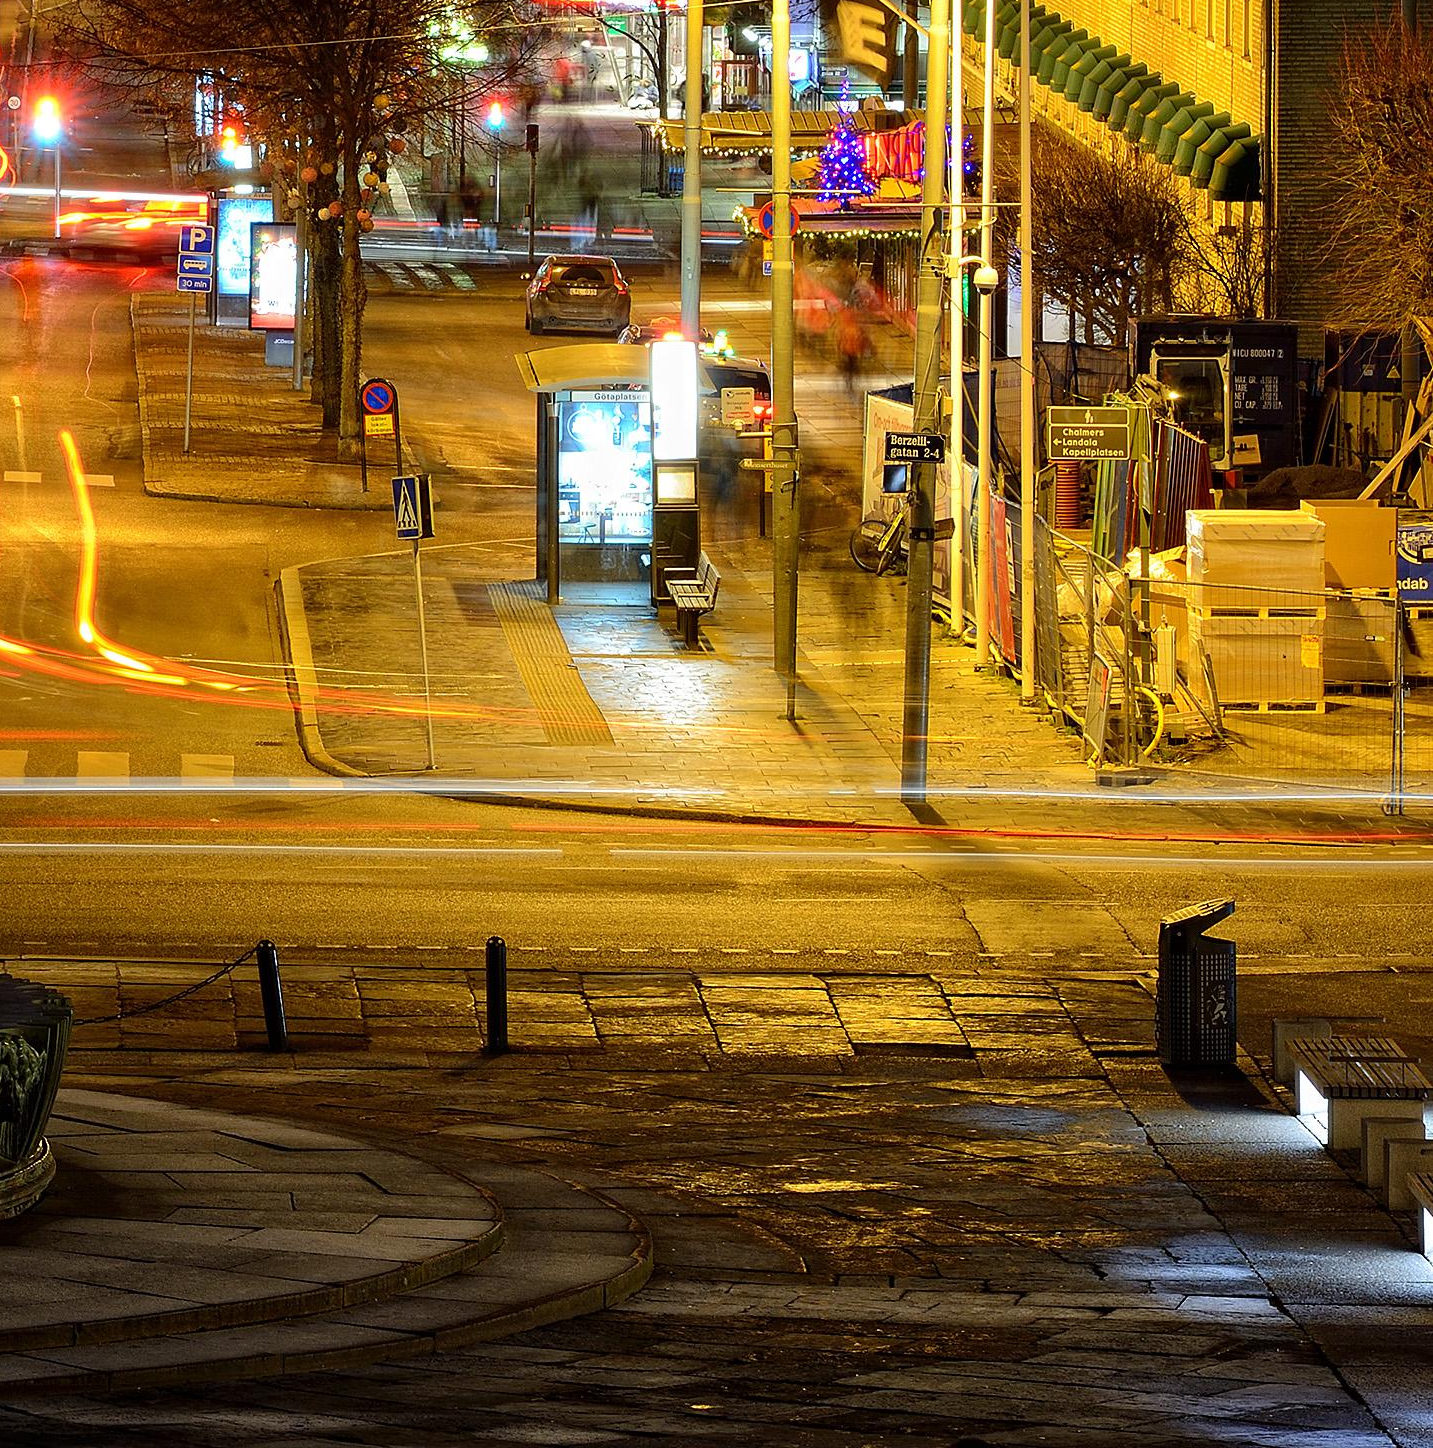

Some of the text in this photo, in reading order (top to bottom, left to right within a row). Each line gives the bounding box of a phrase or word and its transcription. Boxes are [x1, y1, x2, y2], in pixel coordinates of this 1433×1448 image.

[189, 228, 207, 251] P
[182, 279, 208, 289] 30 min
[1250, 348, 1275, 358] 800047
[593, 392, 648, 401] Götaplatsen
[1062, 428, 1105, 437] Chalmers
[890, 434, 931, 447] Berzelii-
[1062, 437, 1098, 446] Landala
[890, 447, 940, 459] gatan 2-4
[1062, 447, 1124, 457] Kapellplatsen
